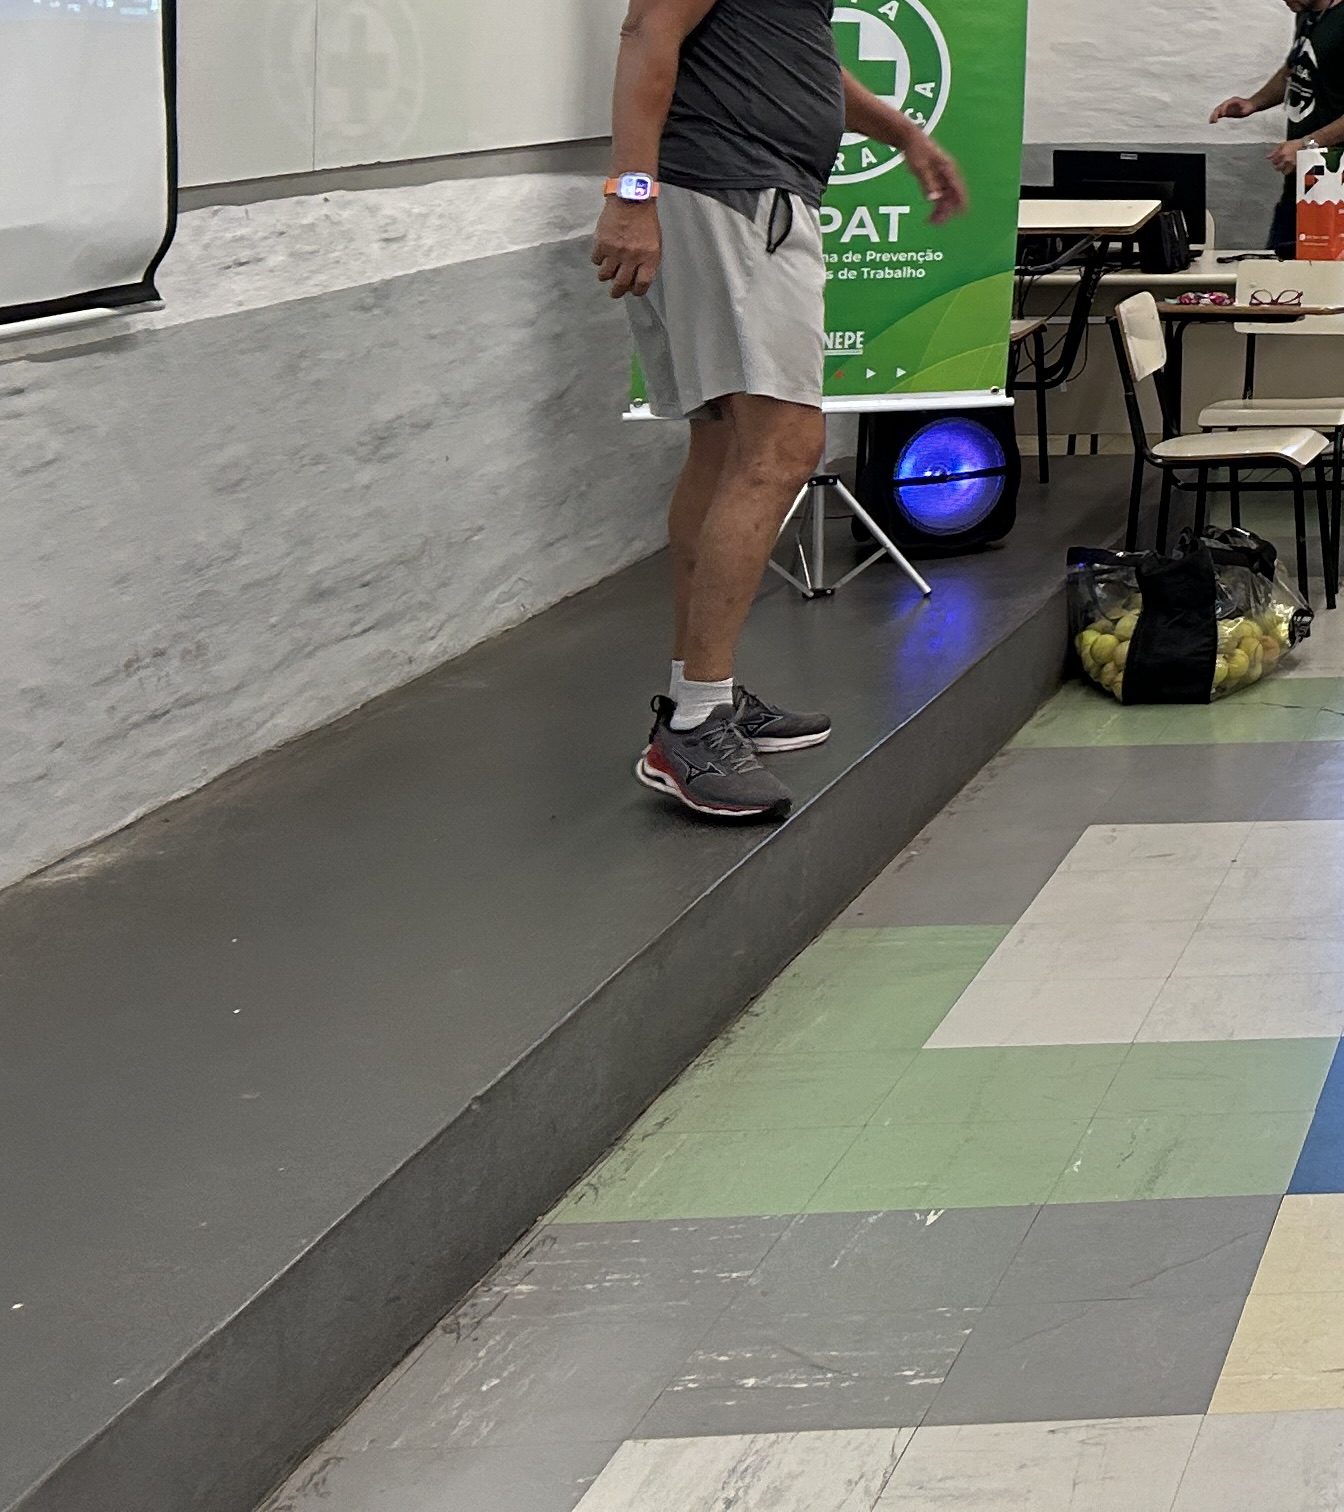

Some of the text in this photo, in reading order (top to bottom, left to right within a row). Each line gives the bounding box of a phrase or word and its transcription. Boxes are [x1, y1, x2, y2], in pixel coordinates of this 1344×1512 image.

[820, 205, 911, 243] PAT
[842, 251, 862, 263] de
[866, 249, 944, 264] Prevenção
[838, 268, 857, 279] de
[861, 266, 926, 279] Trabalho
